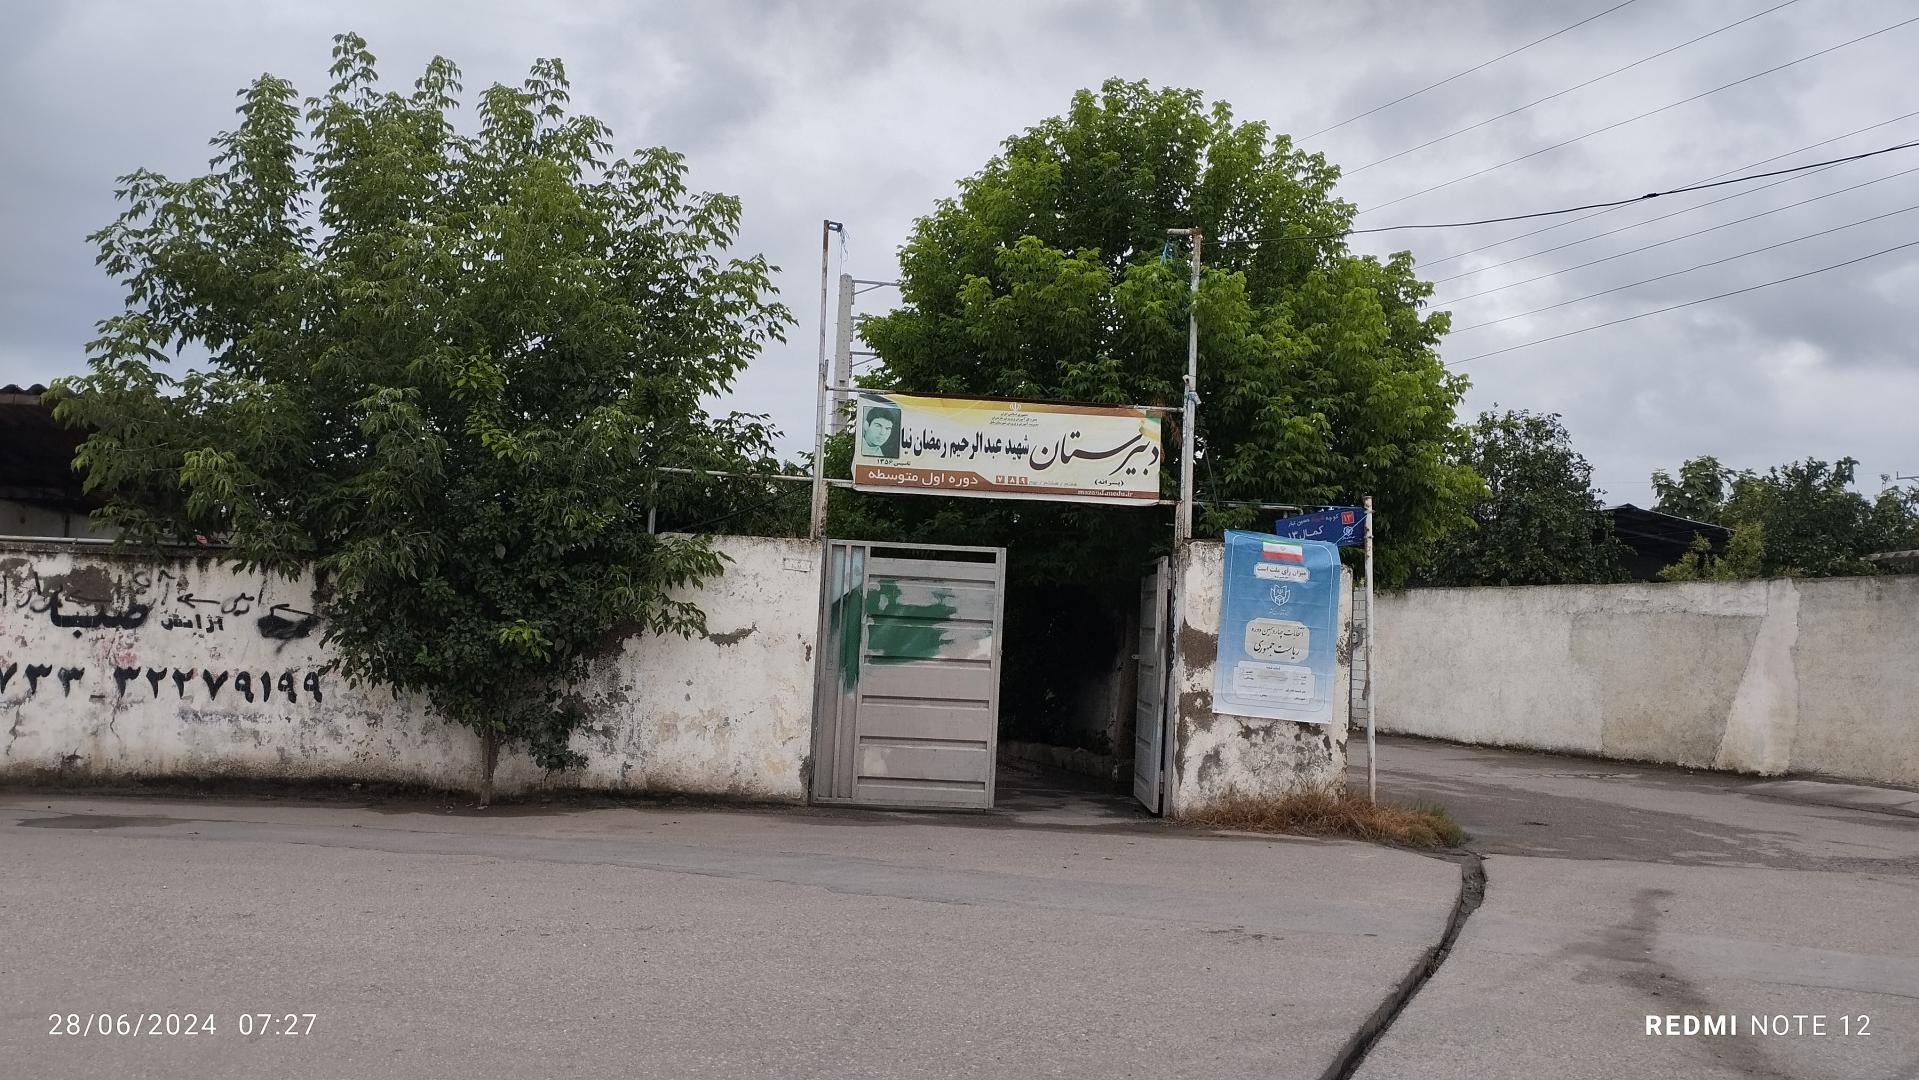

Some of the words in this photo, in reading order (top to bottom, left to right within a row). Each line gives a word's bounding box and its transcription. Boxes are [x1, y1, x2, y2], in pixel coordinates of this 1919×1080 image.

[901, 427, 912, 454] نیا
[913, 428, 947, 458] رمضان
[950, 431, 1002, 460] عبدالرحیم
[1005, 434, 1030, 460] شهید
[1029, 430, 1159, 476] دبیرستان
[868, 469, 919, 483] متوسطه
[921, 472, 944, 486] اول
[948, 475, 979, 487] دوره
[1300, 525, 1324, 540] کمال
[1253, 640, 1275, 657] جمهوری
[1274, 645, 1300, 660] ریاست
[114, 666, 323, 703] ۳۲۲۷۹۱۹۹
